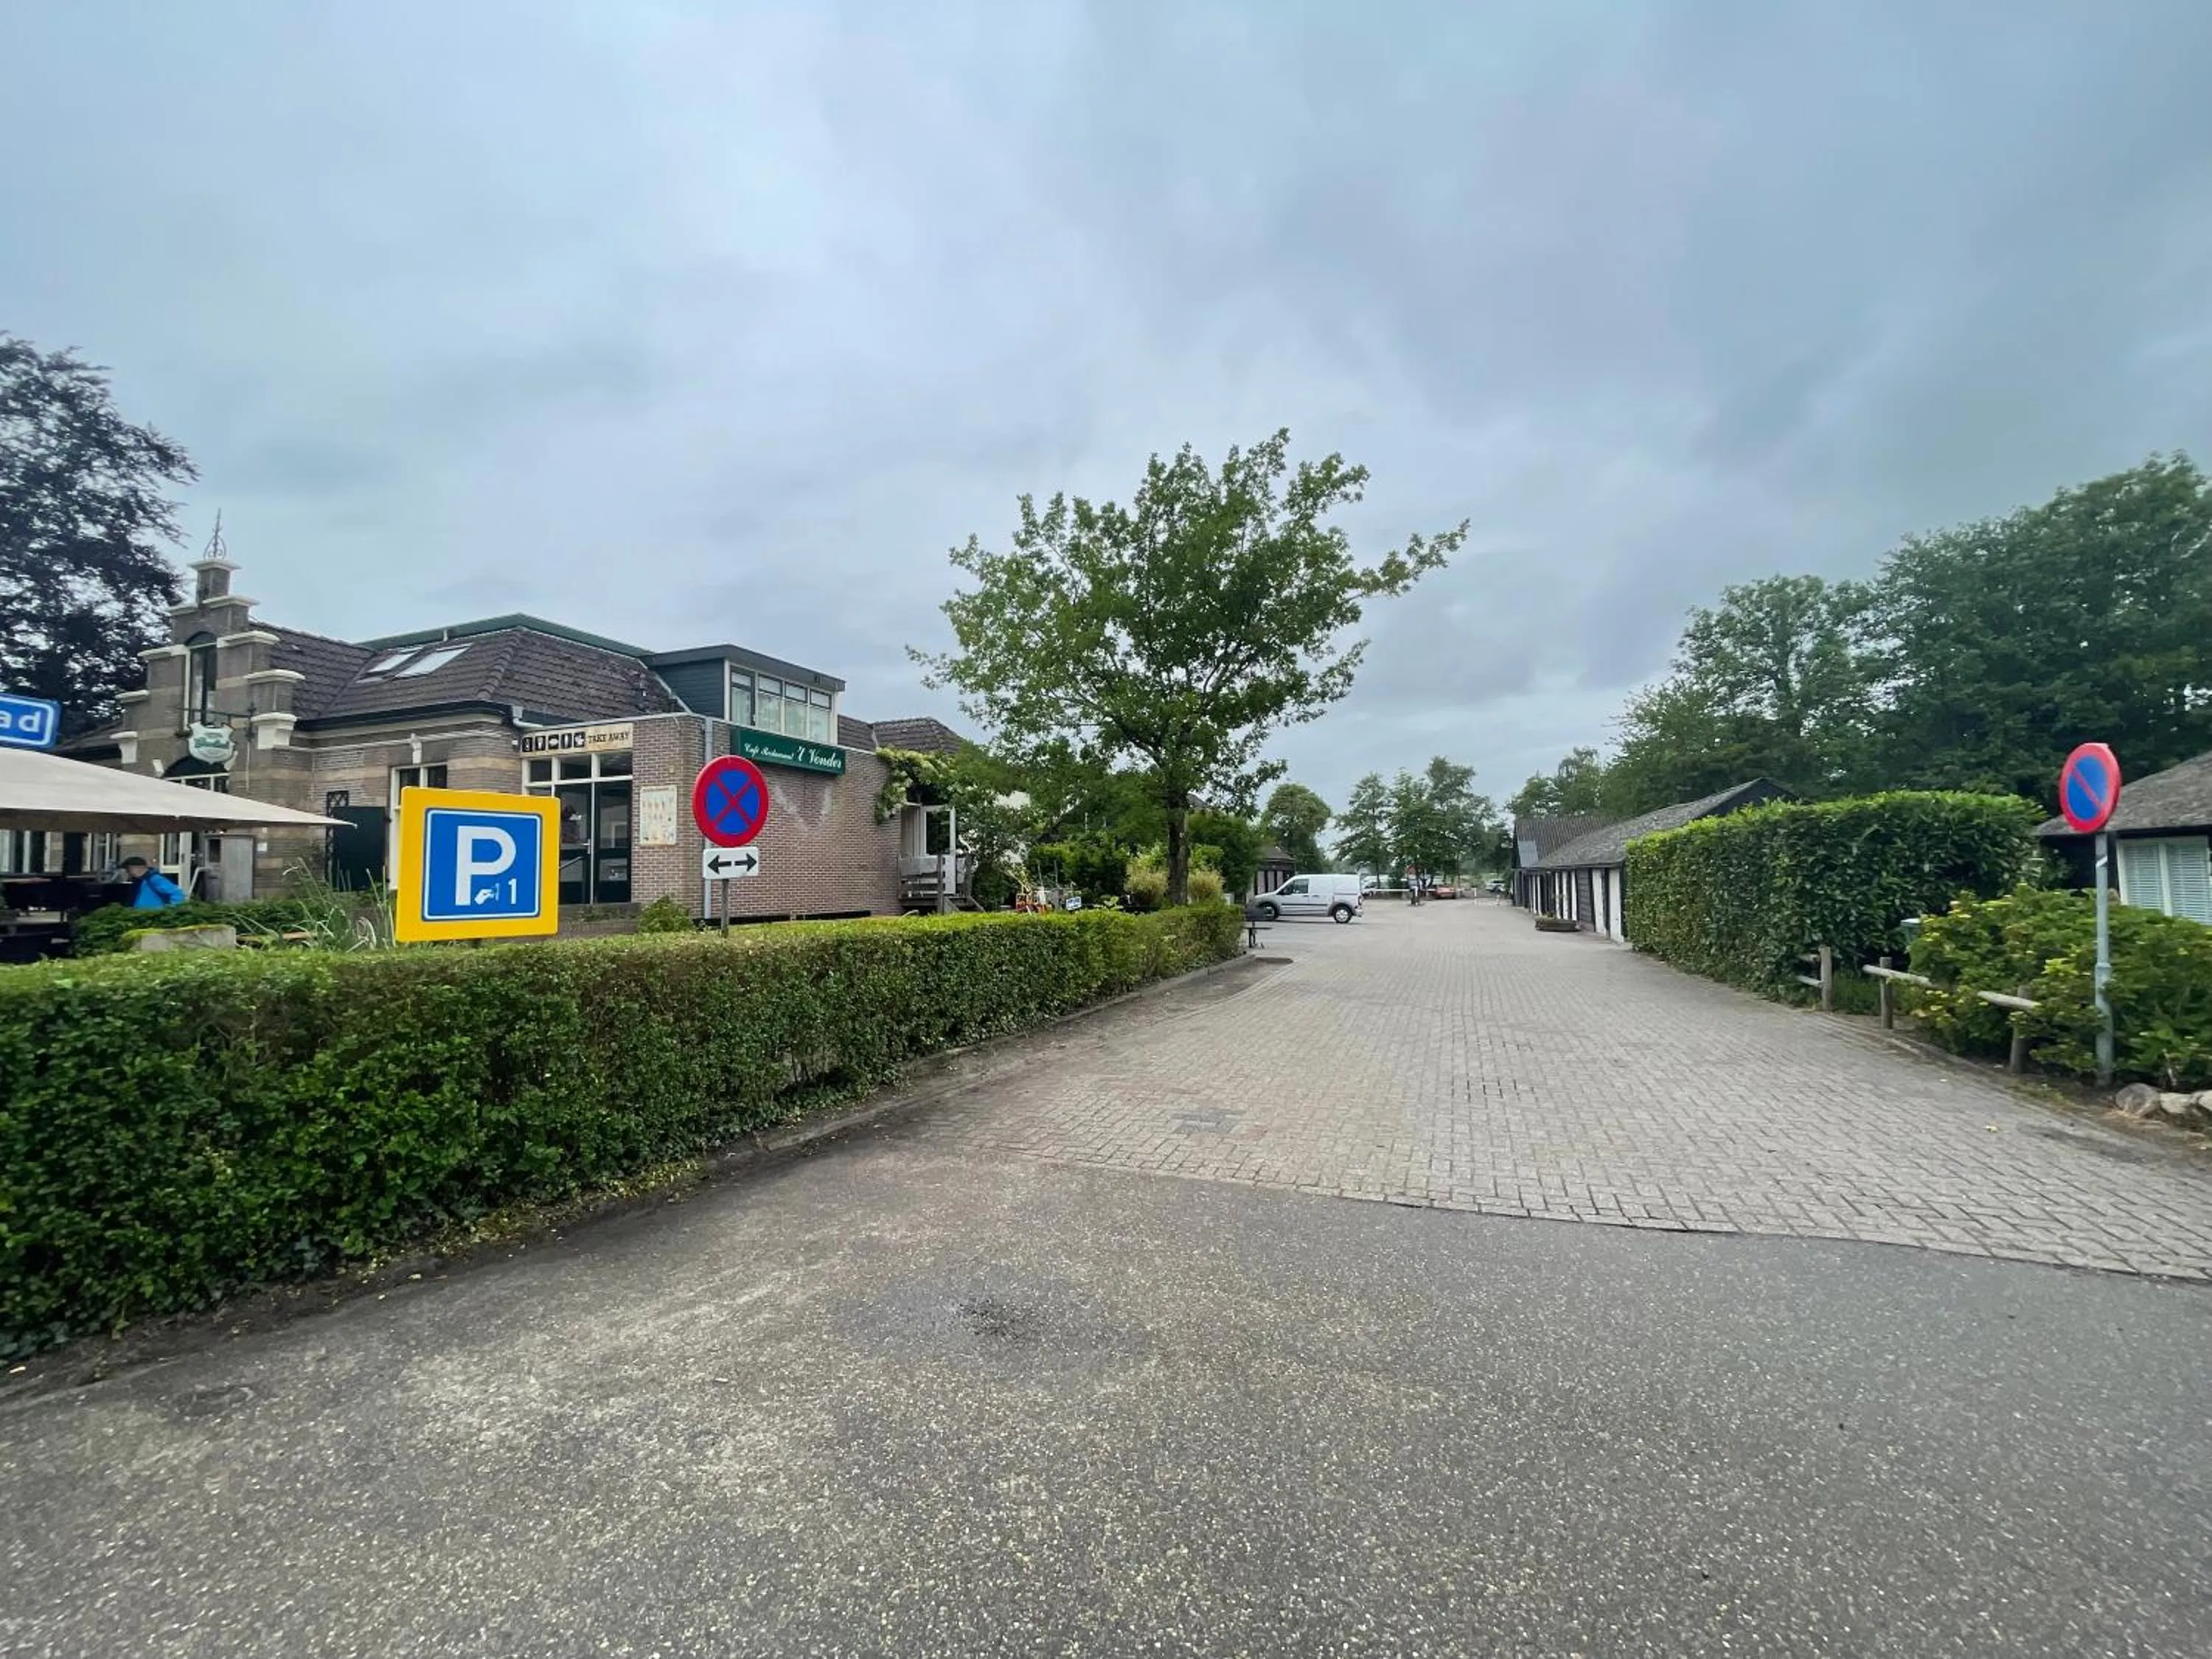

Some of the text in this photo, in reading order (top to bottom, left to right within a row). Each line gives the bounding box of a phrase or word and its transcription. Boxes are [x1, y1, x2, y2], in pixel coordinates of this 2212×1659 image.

[588, 731, 630, 743] TAKE AWAY
[809, 748, 842, 769] Vonder
[455, 825, 517, 906] P
[508, 878, 517, 905] 1
